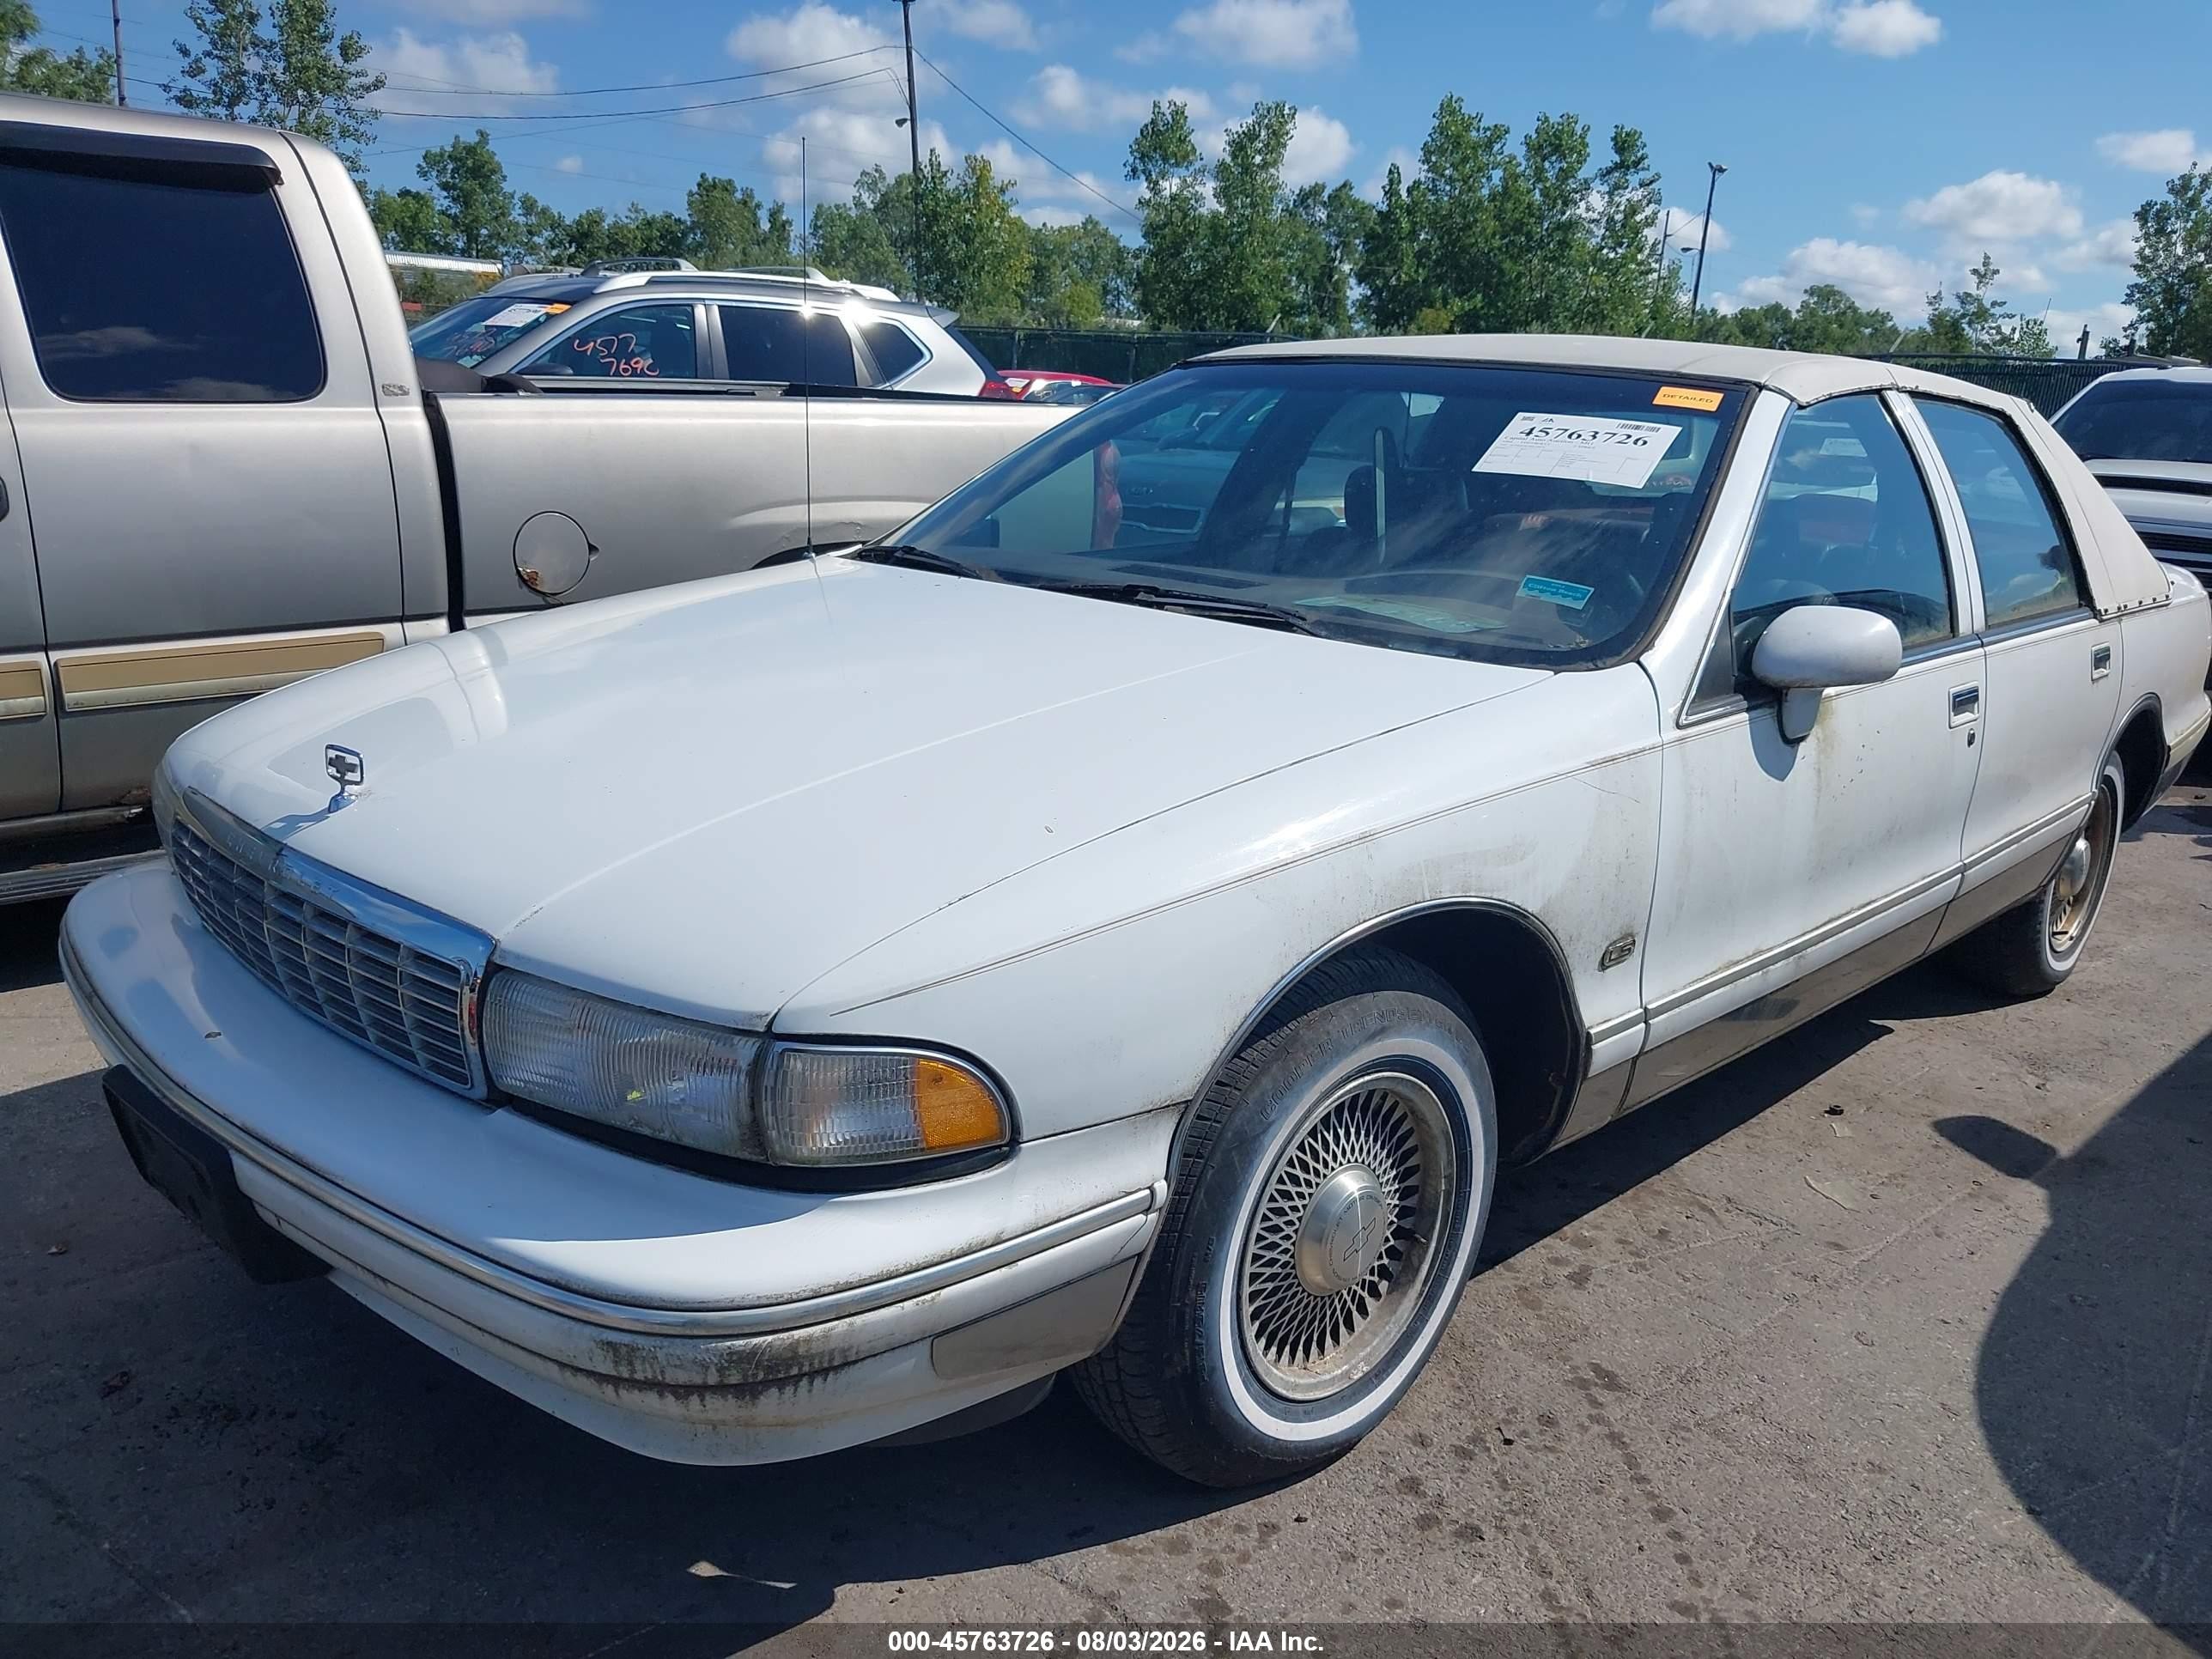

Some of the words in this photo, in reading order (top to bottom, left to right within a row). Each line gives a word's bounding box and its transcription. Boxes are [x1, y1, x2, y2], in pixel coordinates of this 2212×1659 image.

[573, 332, 636, 356] 4577
[1662, 393, 1714, 404] DETAILED
[1519, 426, 1651, 447] 45763726
